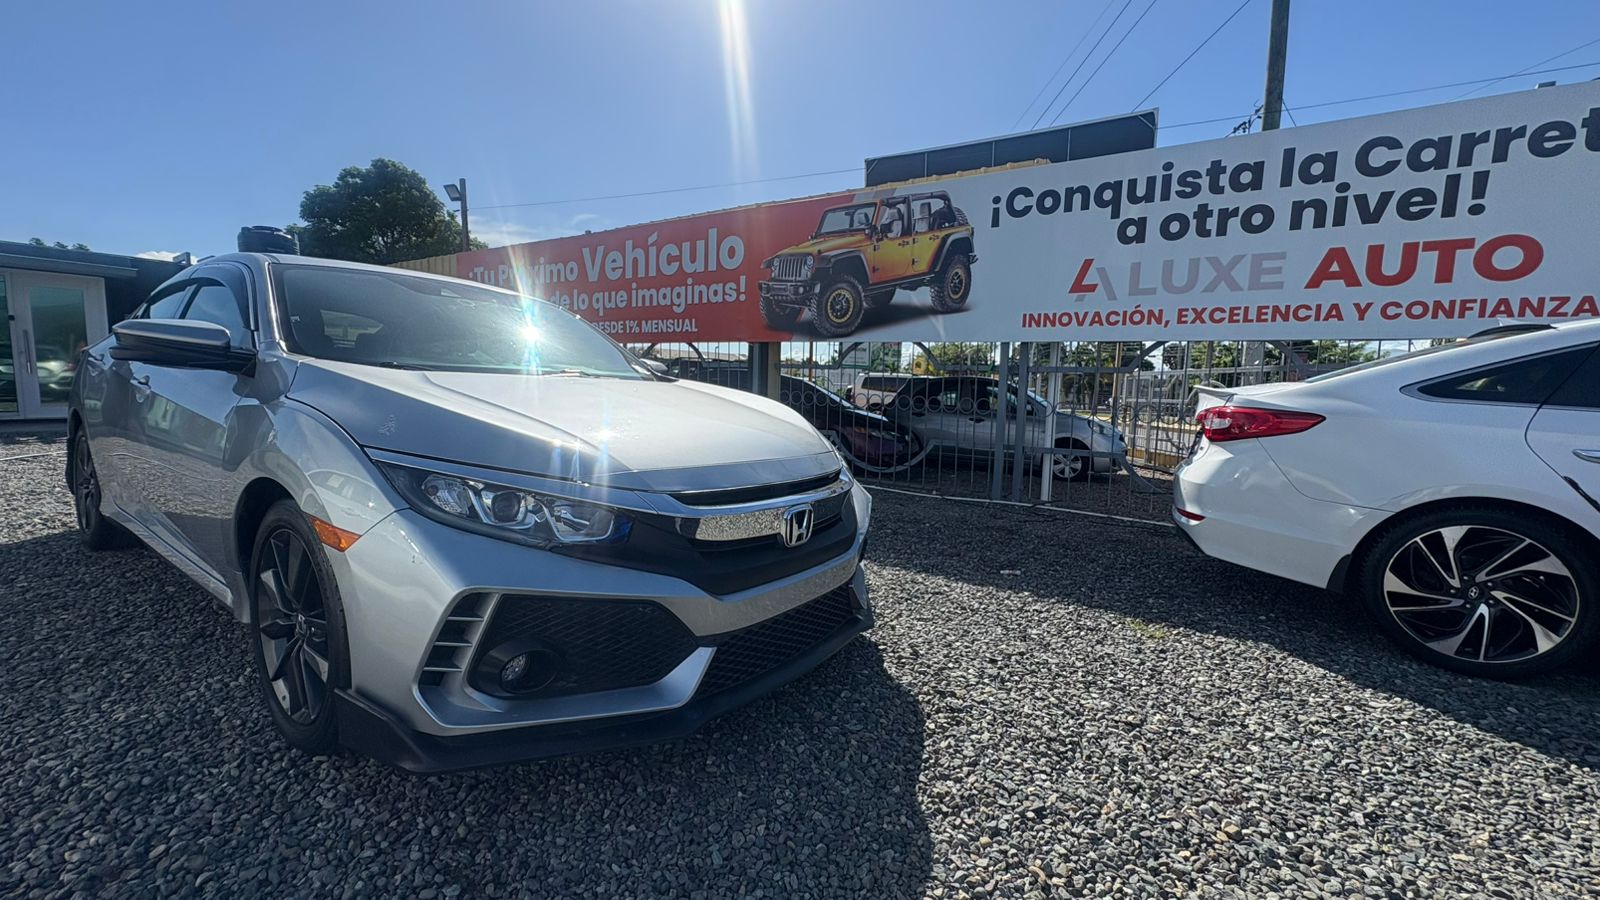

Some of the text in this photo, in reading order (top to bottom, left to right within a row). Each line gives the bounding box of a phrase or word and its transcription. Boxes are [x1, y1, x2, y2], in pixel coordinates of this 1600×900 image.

[991, 160, 1265, 228] ¡Conquista
[1279, 147, 1338, 188] la
[1117, 170, 1490, 245] a otro nivel!
[582, 228, 745, 283] Vehículo
[1128, 251, 1287, 297] LUXE
[1304, 234, 1544, 289] AUTO
[573, 289, 589, 310] lo
[592, 290, 628, 316] que
[631, 275, 747, 314] imaginas!
[1022, 295, 1600, 328] INNOVACIÓN, EXCELENCIA Y CONFIANZA
[626, 320, 639, 333] 1%
[642, 319, 698, 333] MENSUAL
